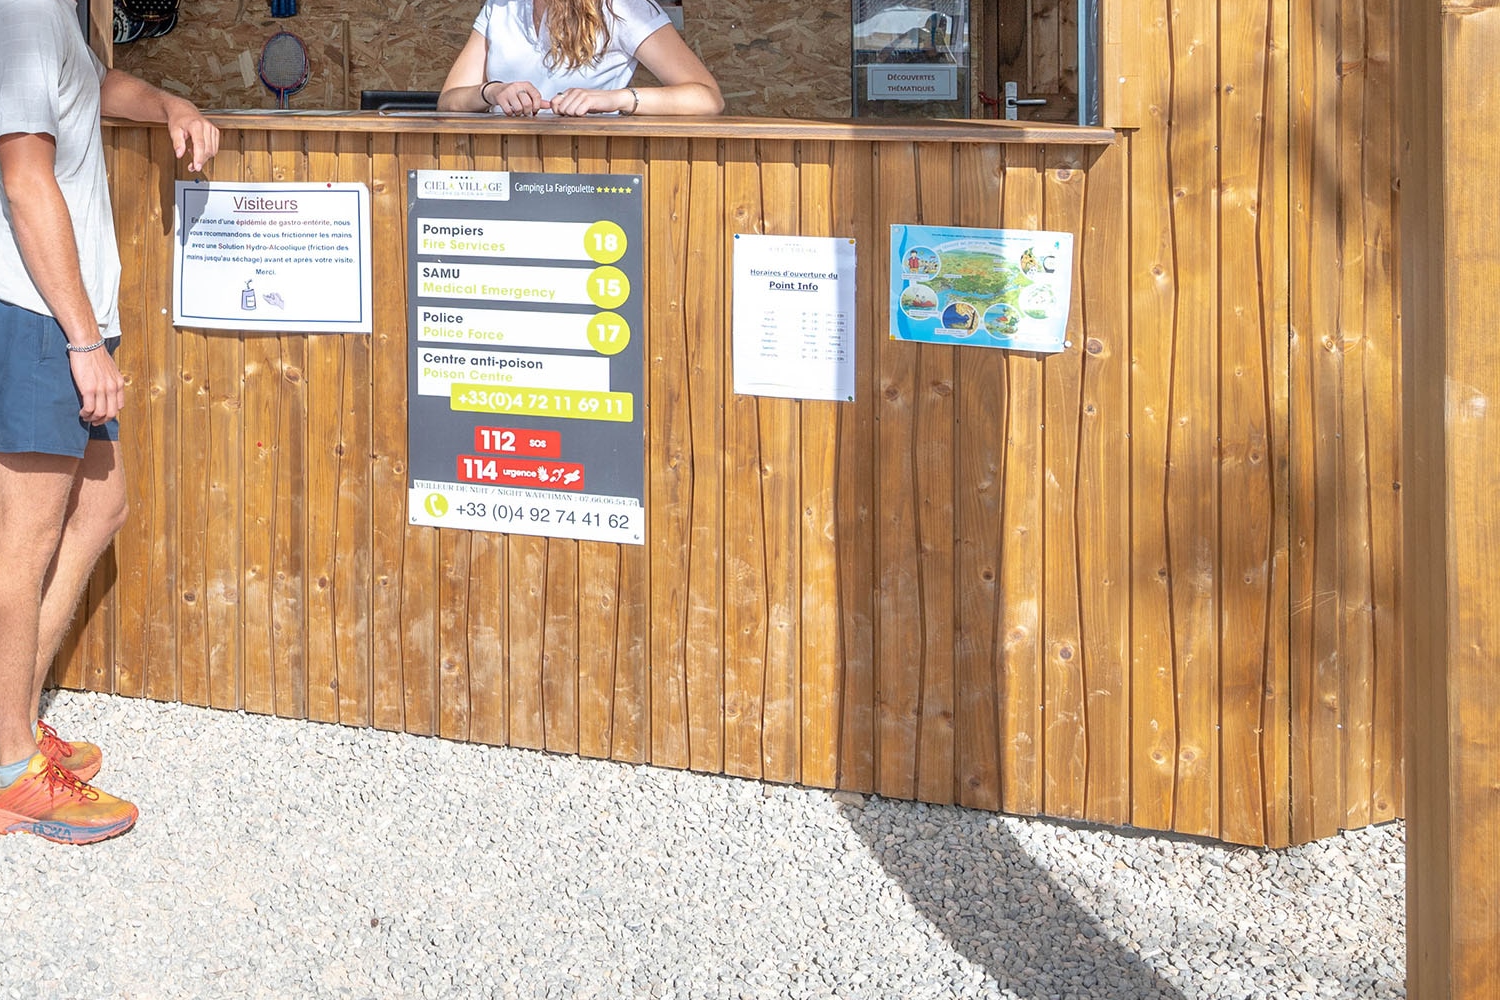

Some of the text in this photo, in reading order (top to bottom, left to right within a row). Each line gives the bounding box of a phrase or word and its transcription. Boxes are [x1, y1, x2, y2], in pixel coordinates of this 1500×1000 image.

[887, 73, 935, 81] DÉCOUVERTES
[887, 84, 935, 92] THÉMATIQUES
[458, 181, 503, 192] VILLAGE
[514, 182, 545, 194] Camping
[546, 183, 554, 193] La
[555, 184, 595, 195] Farigoulette
[233, 195, 298, 211] Visiteurs
[191, 216, 199, 224] En
[200, 217, 217, 225] raison
[236, 218, 267, 227] épidémie
[204, 230, 251, 238] recommandons
[331, 231, 353, 239] mains
[423, 223, 484, 238] Pompiers
[246, 243, 306, 252] Hydro-Alcoolique
[307, 243, 335, 252] (friction
[423, 238, 506, 252] Fire Services
[593, 233, 618, 252] 18
[186, 253, 203, 261] mains
[204, 254, 231, 263] jusqu'au
[232, 255, 262, 264] séchage)
[293, 256, 313, 264] après
[423, 267, 460, 279] SAMU
[750, 268, 838, 280] Horaires d'ouverture du
[423, 281, 556, 299] Medical Emergency
[596, 278, 621, 297] 15
[769, 280, 819, 291] Point Info
[423, 311, 464, 324] Police
[423, 326, 504, 341] Police Force
[596, 323, 621, 343] 17
[423, 352, 544, 370] Centre anti-poison
[423, 367, 513, 383] Poison Centre
[458, 389, 623, 415] +33(0)4 72 11 69 11
[480, 429, 516, 452] 112
[463, 458, 537, 481] 114 urgence
[415, 481, 454, 491] VEILLEUR
[456, 484, 467, 492] DE
[470, 486, 489, 494] NUIT
[498, 488, 523, 497] NIGHT
[525, 491, 572, 501] WATCHMAN
[456, 502, 629, 529] +33 (0)4 92 74 41 62
